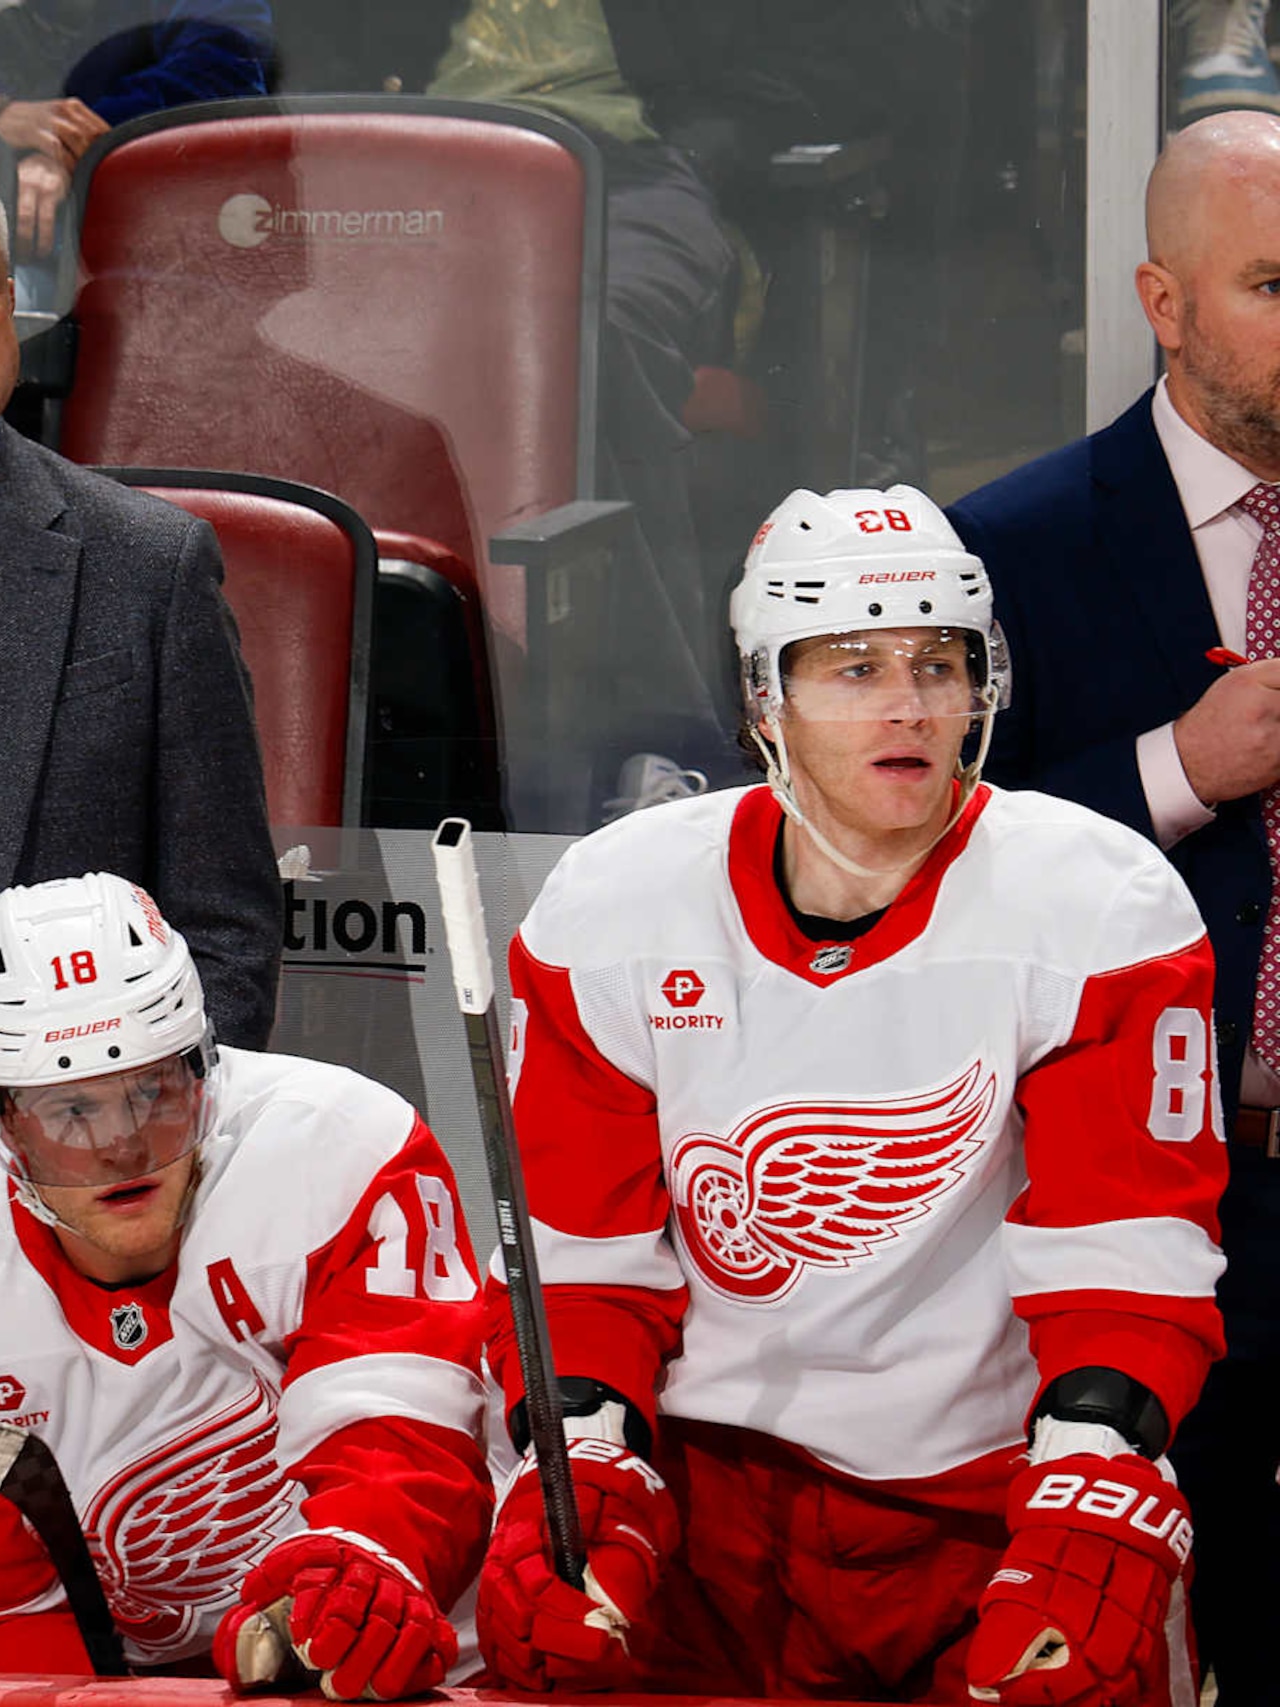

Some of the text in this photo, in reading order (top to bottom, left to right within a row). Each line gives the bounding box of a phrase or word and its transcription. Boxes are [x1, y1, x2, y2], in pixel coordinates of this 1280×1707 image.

[255, 203, 444, 234] zimmerman
[51, 951, 97, 991] 18
[365, 1172, 478, 1302] 18
[206, 1256, 266, 1343] A
